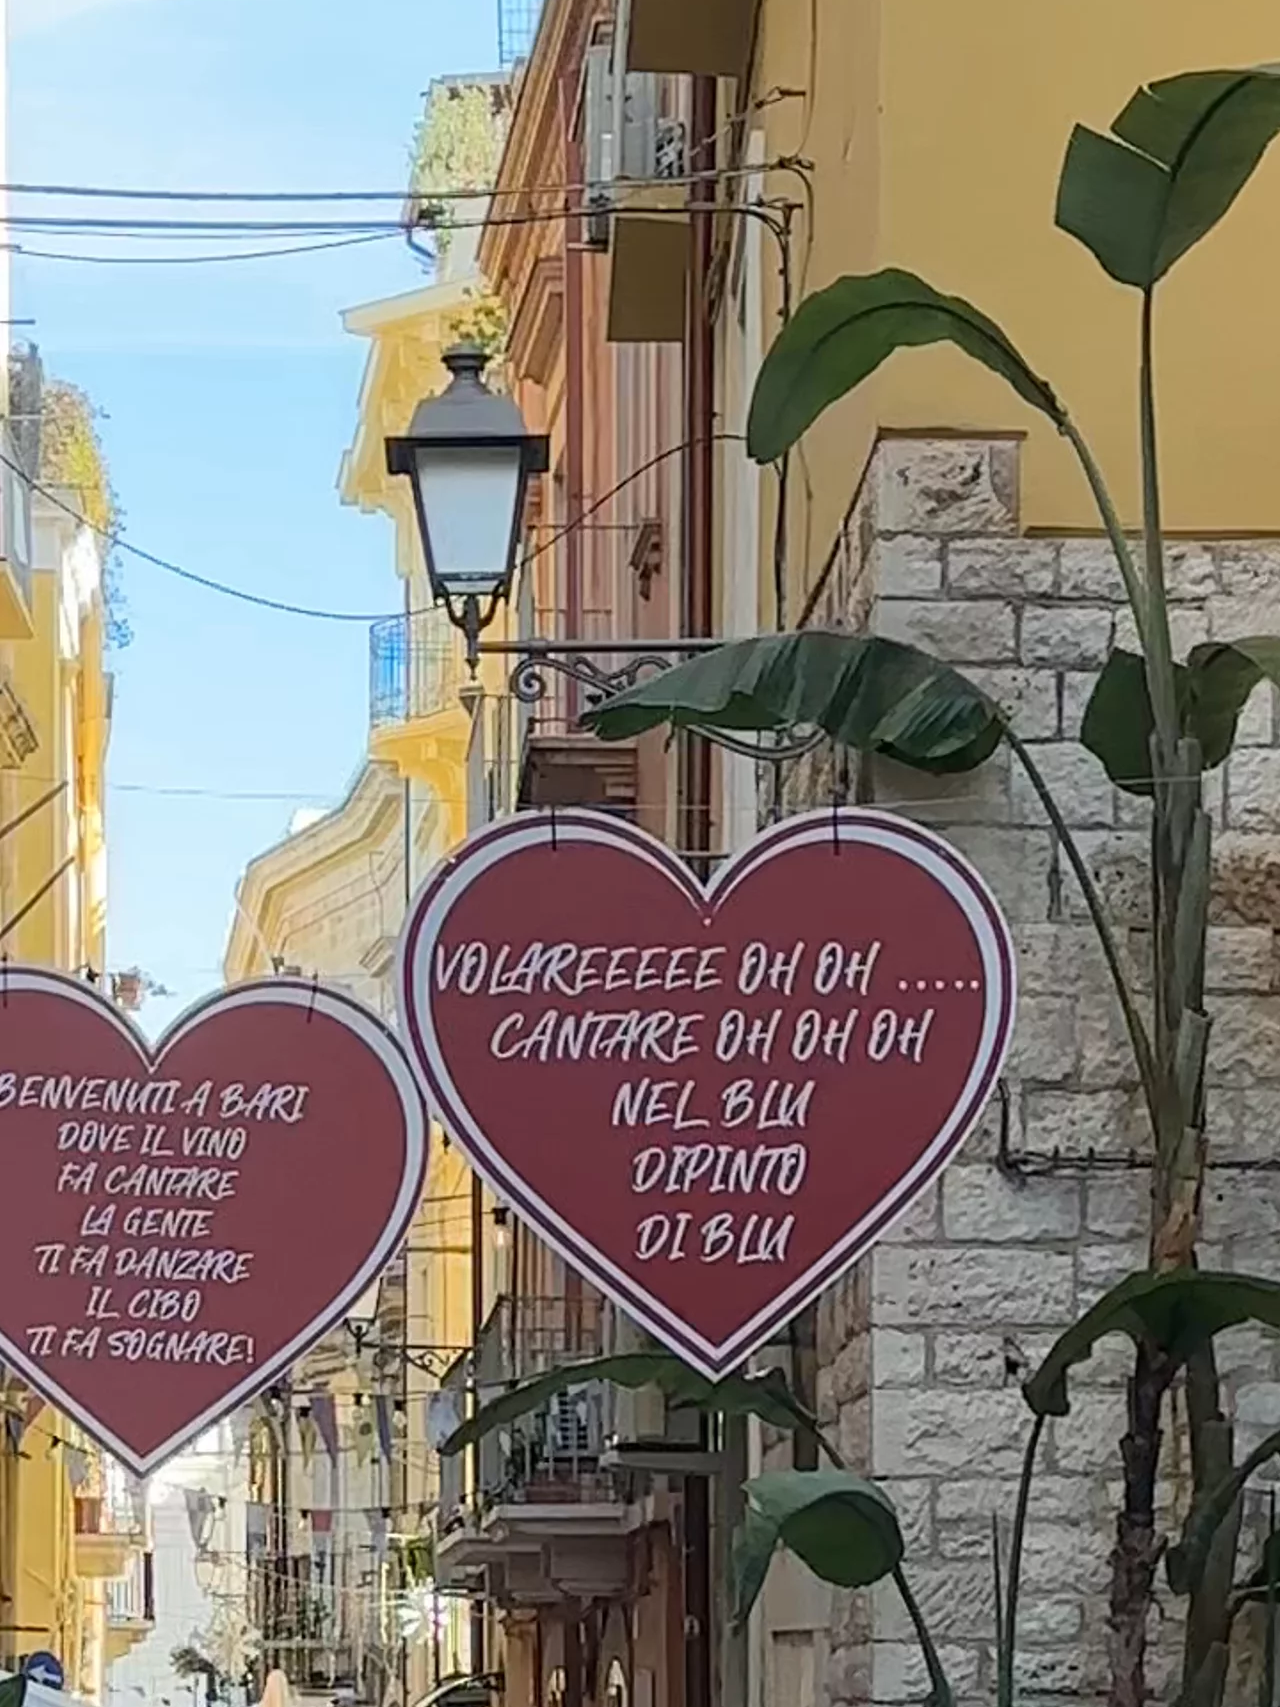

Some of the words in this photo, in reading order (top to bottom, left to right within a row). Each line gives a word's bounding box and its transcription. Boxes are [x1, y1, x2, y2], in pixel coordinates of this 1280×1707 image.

[436, 941, 727, 996] VOLAREEEEE
[738, 941, 805, 996] OH
[814, 941, 881, 996] OH
[490, 1009, 705, 1063] CANTARE
[716, 1008, 783, 1063] OH
[792, 1008, 859, 1064] OH
[868, 1008, 934, 1063] OH
[180, 1080, 213, 1118] A
[219, 1083, 309, 1123] BARI
[612, 1077, 710, 1130] NEL
[721, 1078, 815, 1130] BLU
[57, 1120, 135, 1153] DOVE
[139, 1123, 175, 1157] IL
[182, 1126, 247, 1160] VINO
[57, 1161, 98, 1195] FA
[104, 1163, 239, 1201] CANTARE
[632, 1143, 806, 1195] DIPINTO
[80, 1203, 117, 1237] LA
[123, 1206, 214, 1238] GENTE
[635, 1212, 693, 1261] DI
[700, 1212, 795, 1264] BLU
[34, 1243, 66, 1274] TI
[69, 1244, 109, 1277] FA
[114, 1246, 254, 1284] DANZARE
[85, 1285, 120, 1319] IL
[128, 1288, 201, 1322] CIBO
[26, 1326, 57, 1357] TI
[61, 1326, 102, 1359] FA
[107, 1328, 254, 1366] SOGNARE!
